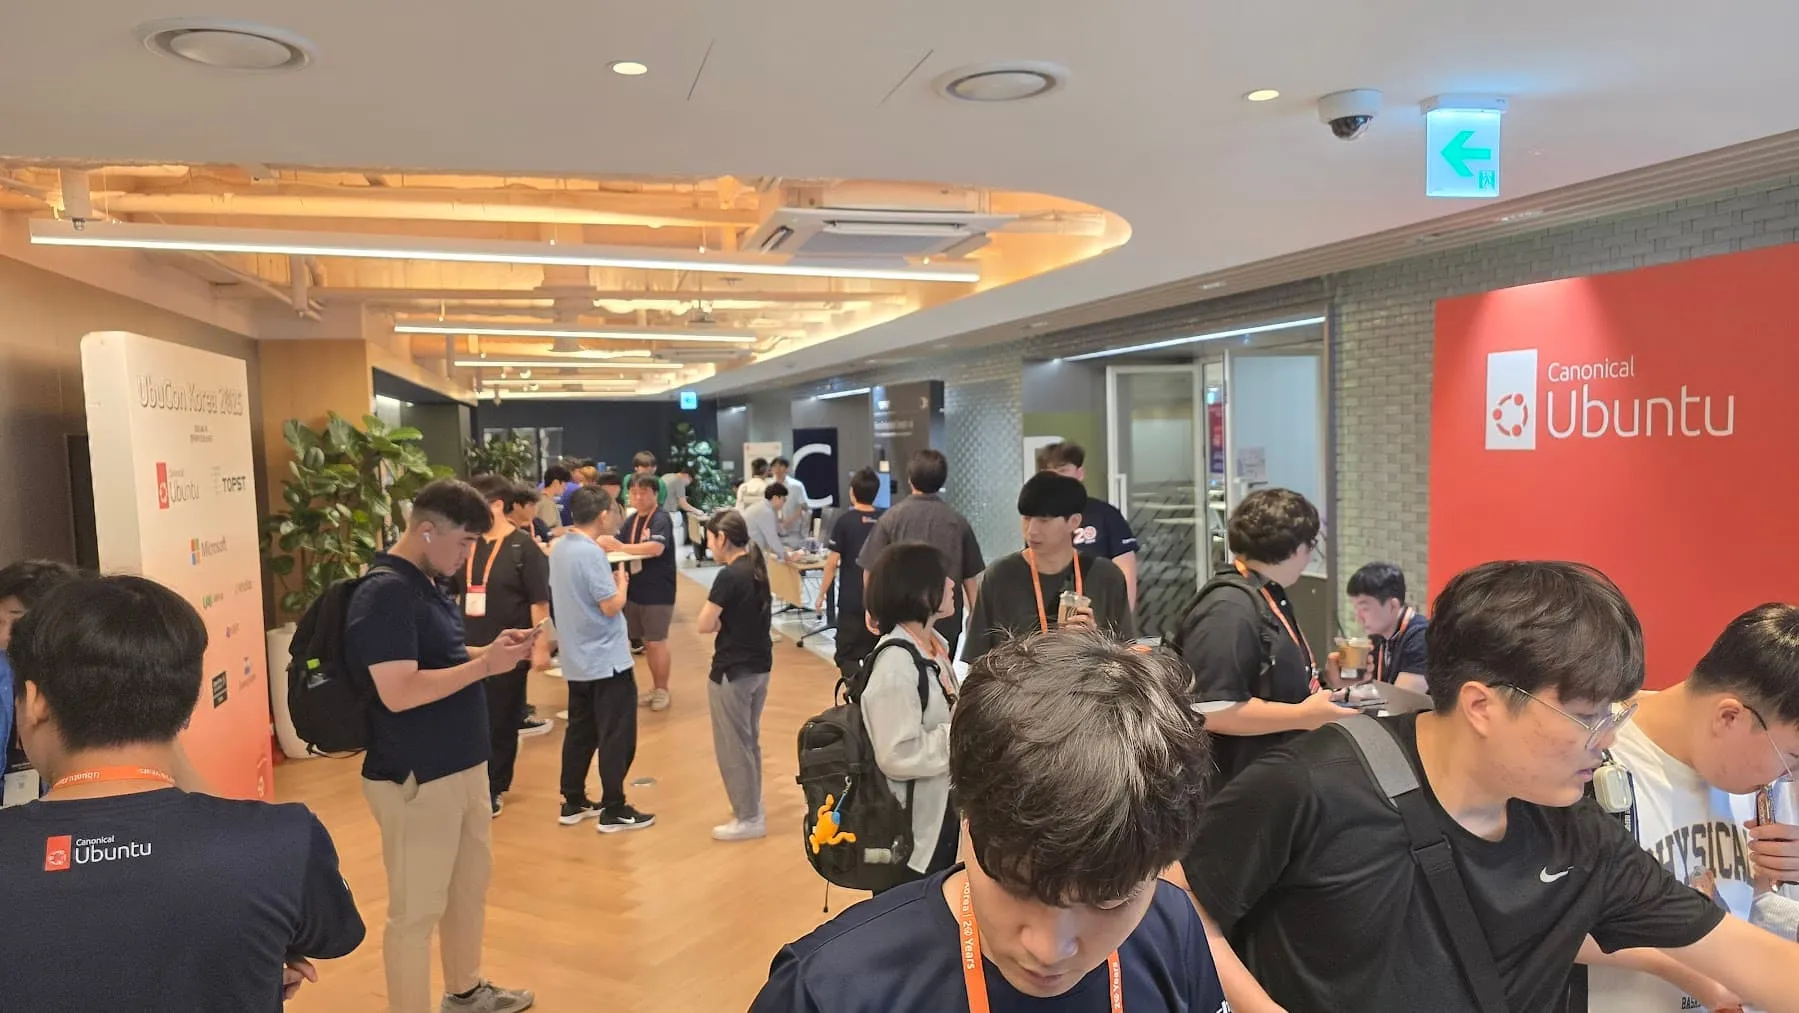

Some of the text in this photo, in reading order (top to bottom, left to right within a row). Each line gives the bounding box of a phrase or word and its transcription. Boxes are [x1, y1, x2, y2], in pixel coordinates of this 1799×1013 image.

[1547, 355, 1635, 382] Canonical
[138, 375, 186, 411] UbuCon
[1546, 384, 1735, 438] Ubuntu
[169, 480, 200, 503] Ubuntu
[222, 476, 246, 493] TOPST
[75, 842, 152, 864] Ubuntu
[76, 835, 115, 846] Canonical
[1648, 821, 1753, 886] HYSICA
[964, 938, 975, 970] Years
[1112, 962, 1120, 992] Years
